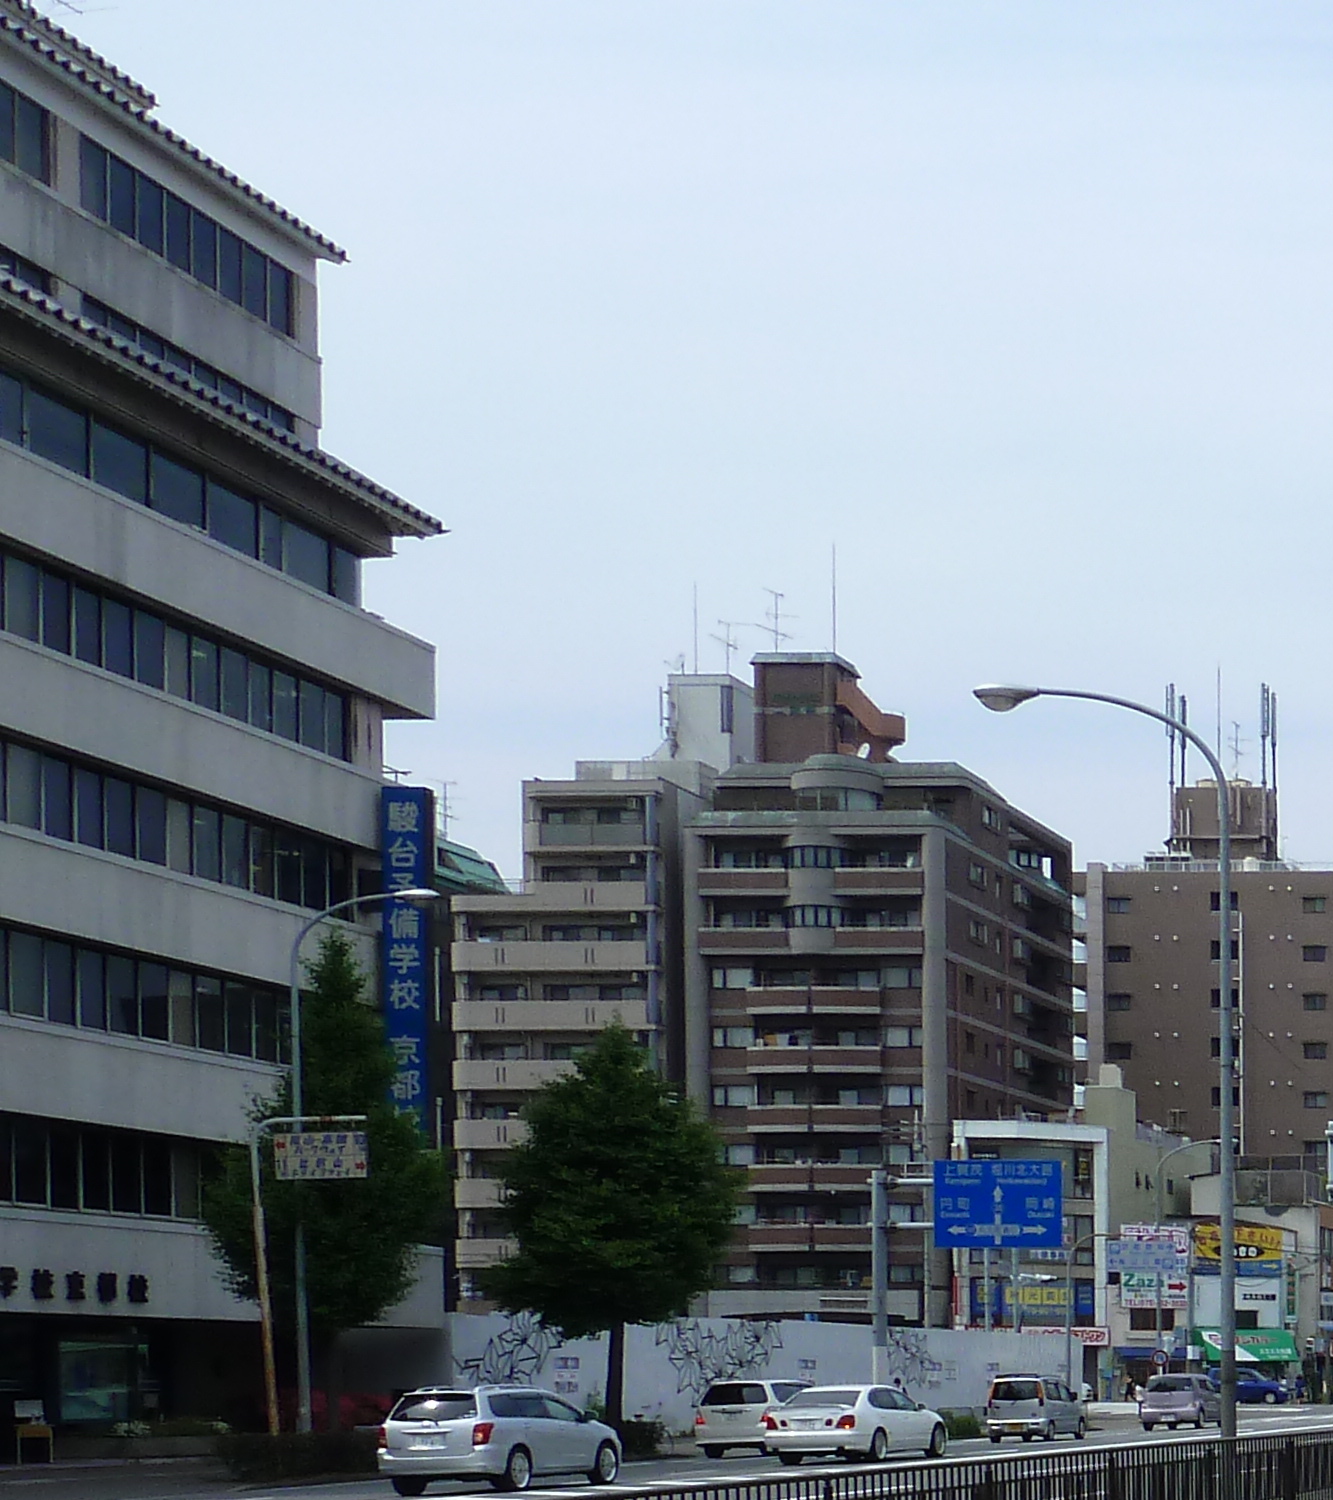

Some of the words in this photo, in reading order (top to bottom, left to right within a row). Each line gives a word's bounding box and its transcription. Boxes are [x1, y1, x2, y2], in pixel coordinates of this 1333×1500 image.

[386, 801, 421, 1010] 駿台予備学校
[943, 1163, 983, 1177] 上賀茂
[991, 1163, 1053, 1177] 堀川北大路
